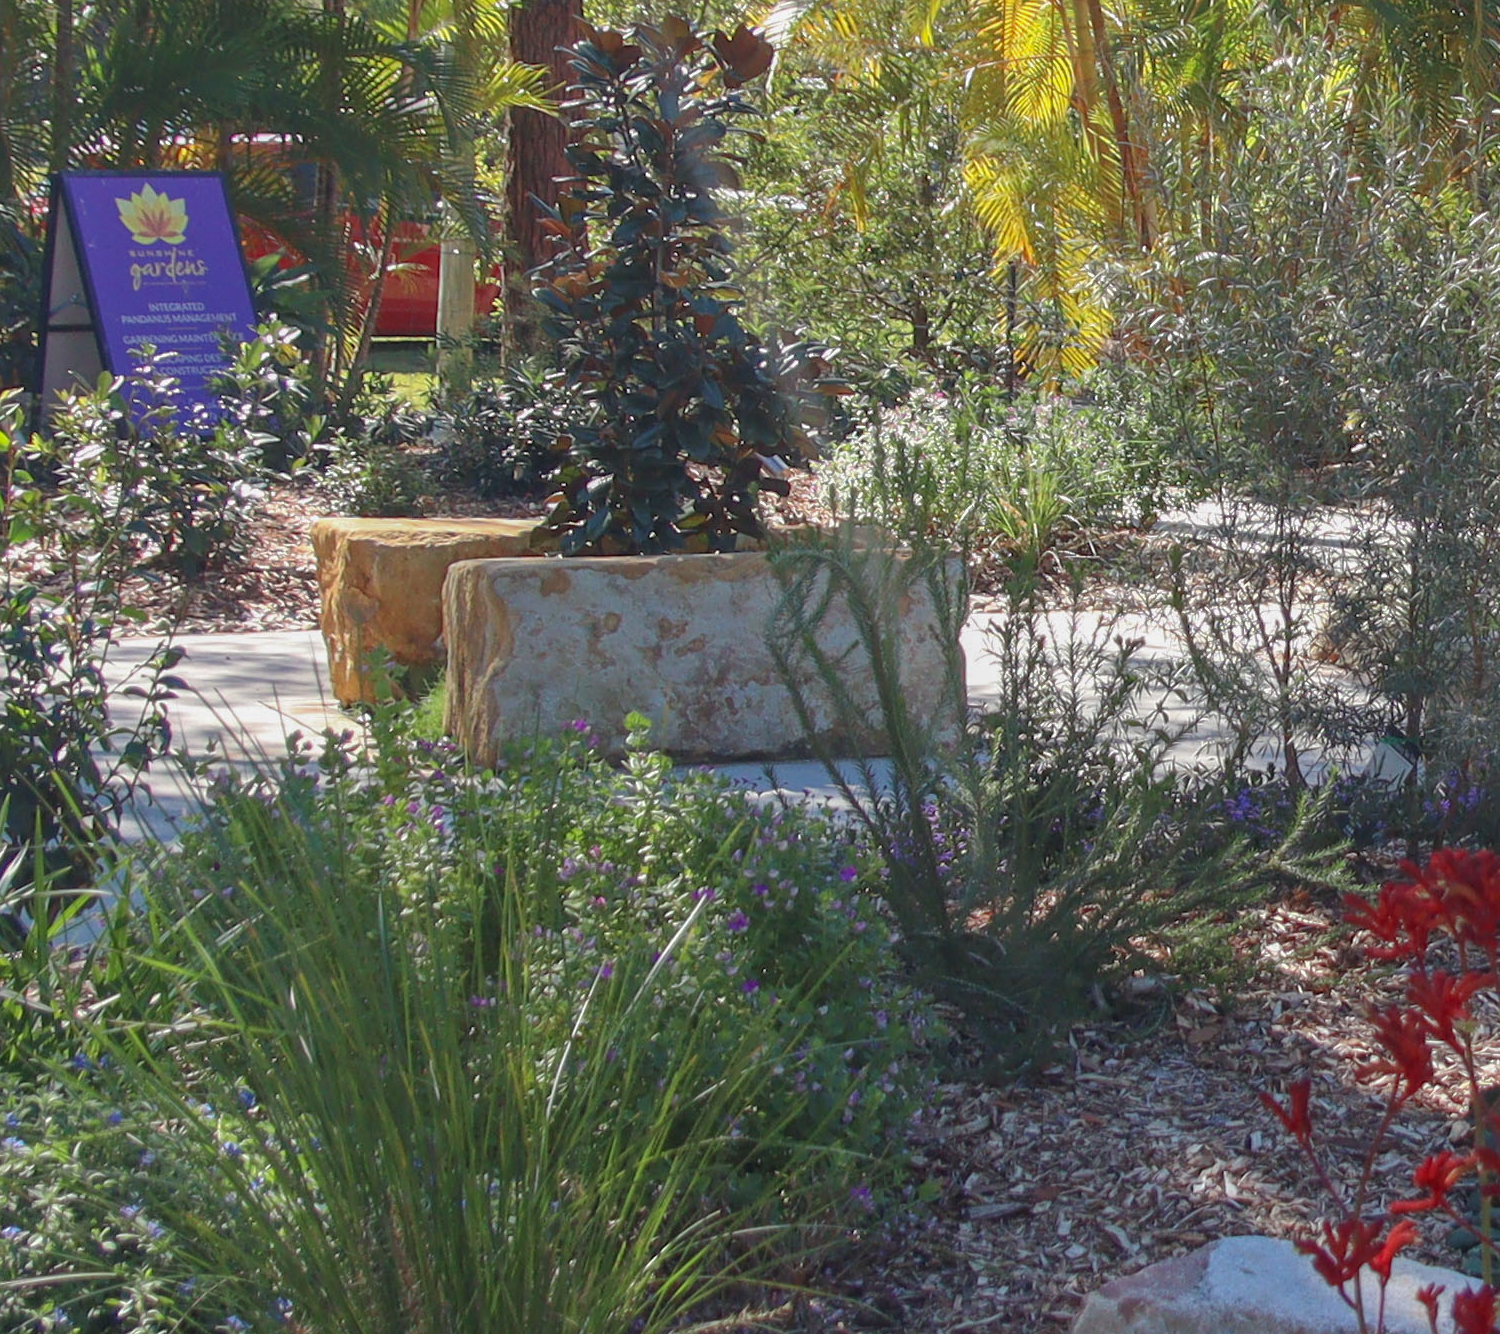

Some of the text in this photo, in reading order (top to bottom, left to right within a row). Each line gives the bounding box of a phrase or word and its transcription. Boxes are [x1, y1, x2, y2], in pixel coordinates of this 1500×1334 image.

[130, 247, 207, 291] gardens
[148, 302, 205, 312] INTEGRATED
[121, 312, 237, 324] PANDANUS MANAGEMENT
[122, 335, 178, 345] GARDENING
